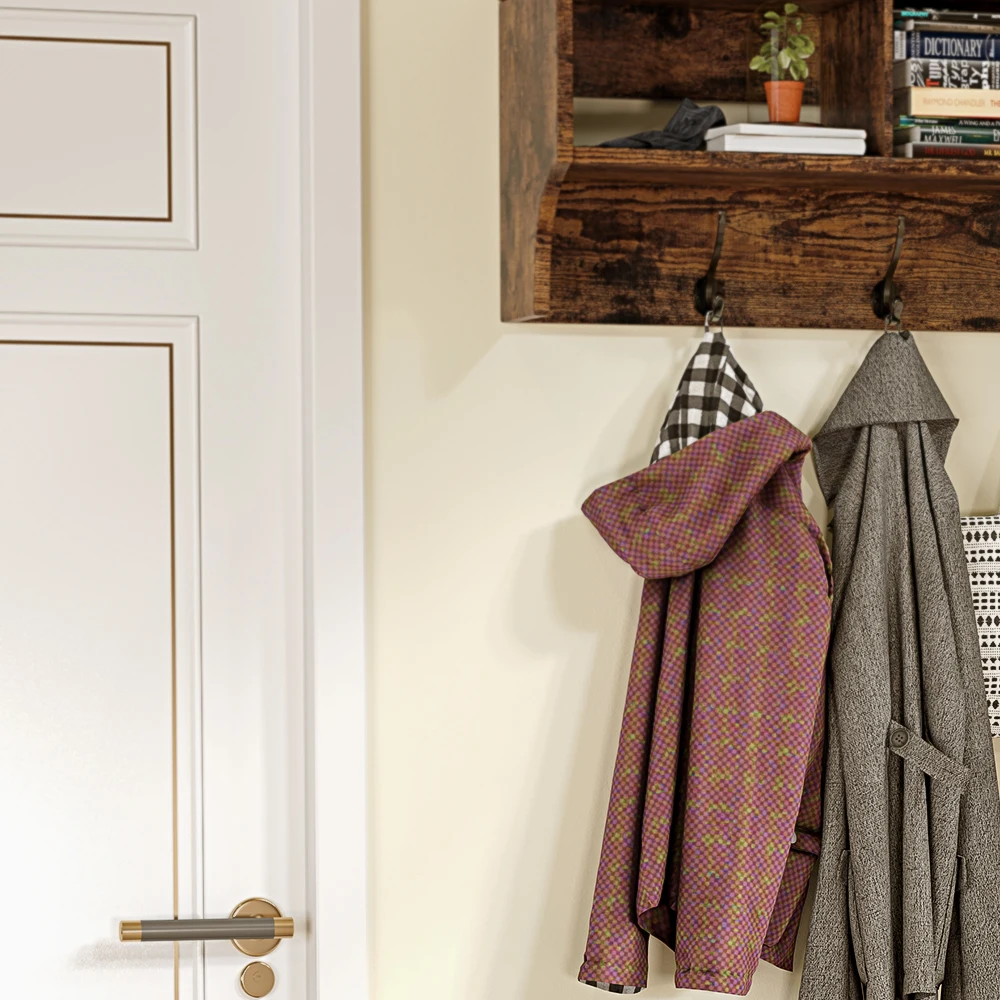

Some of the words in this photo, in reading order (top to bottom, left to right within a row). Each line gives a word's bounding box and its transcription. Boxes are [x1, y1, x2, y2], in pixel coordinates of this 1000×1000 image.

[924, 37, 983, 58] DICTIONARY
[923, 98, 954, 106] RAYMOND
[955, 99, 986, 107] CHANDLER
[990, 100, 1000, 108] THE
[931, 126, 957, 134] JAMES
[924, 135, 963, 144] MAXWELL
